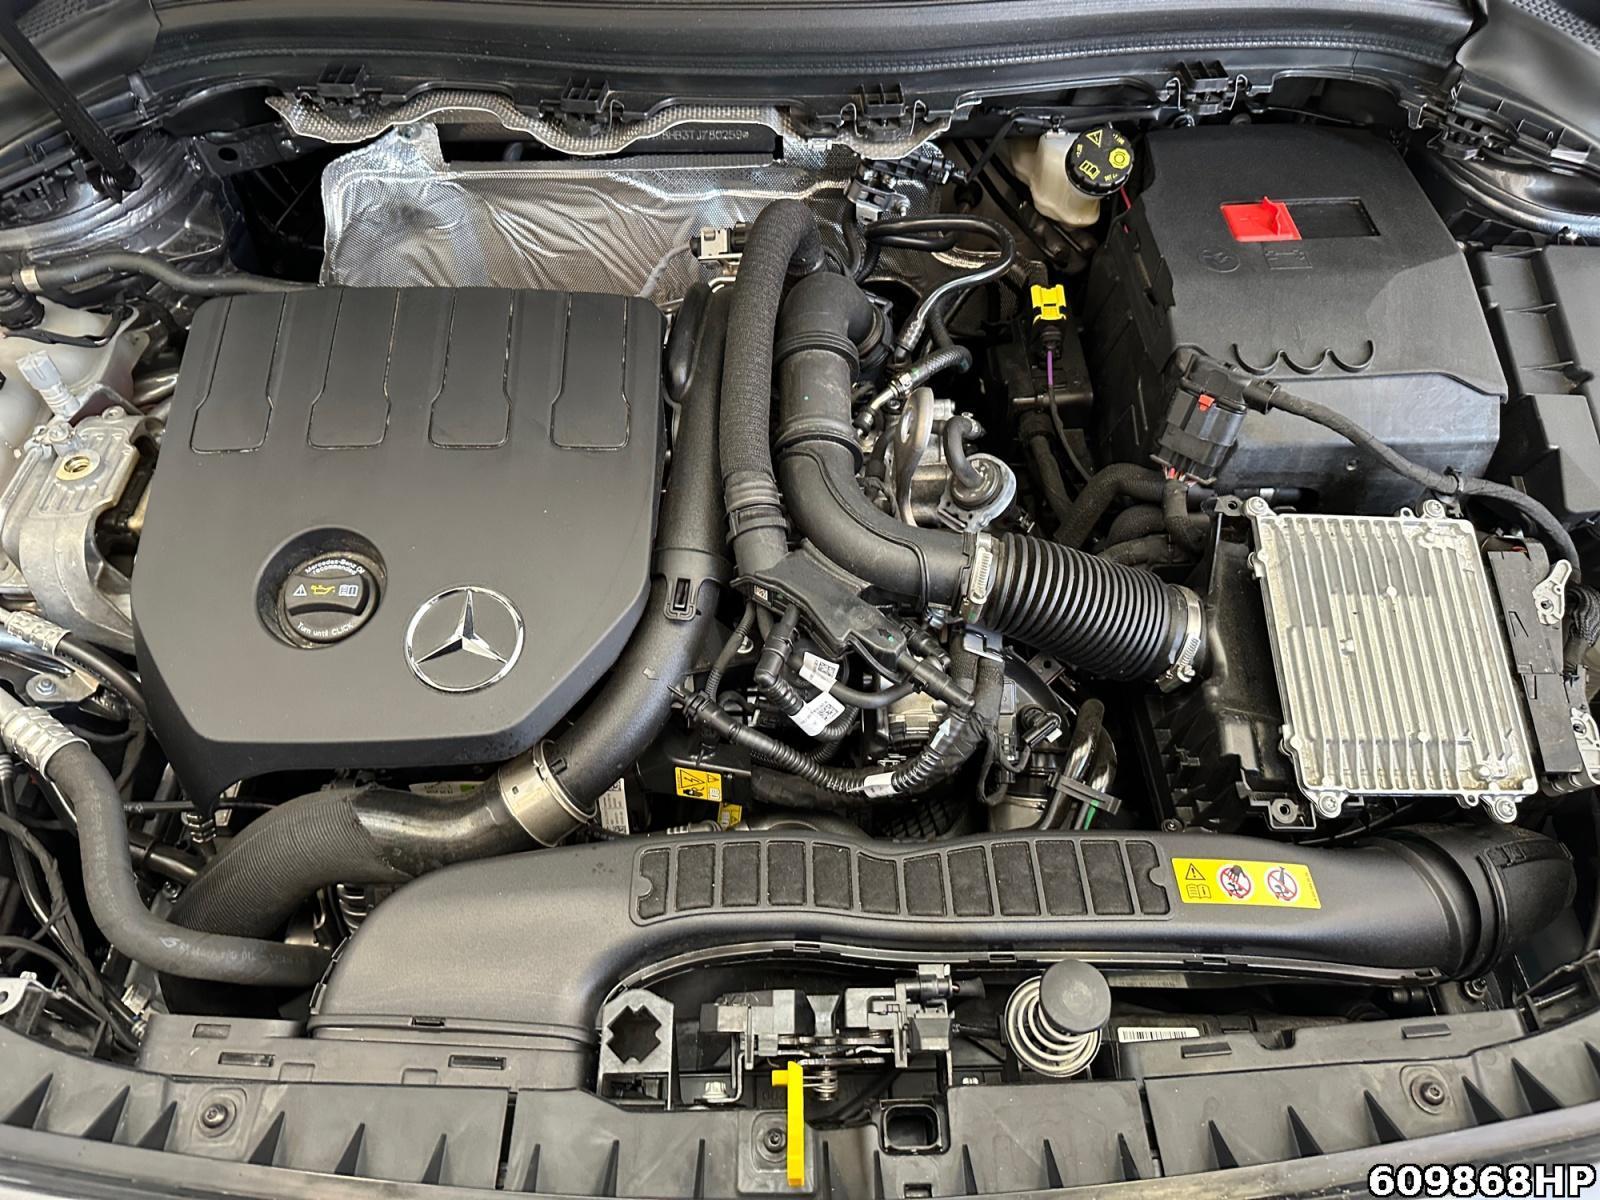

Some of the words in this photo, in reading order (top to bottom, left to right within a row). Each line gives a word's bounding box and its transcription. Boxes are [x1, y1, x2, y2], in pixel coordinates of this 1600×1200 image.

[304, 559, 357, 574] Mercedes-Benz
[297, 621, 311, 635] Turn
[313, 629, 329, 637] until
[331, 623, 354, 636] CLICK
